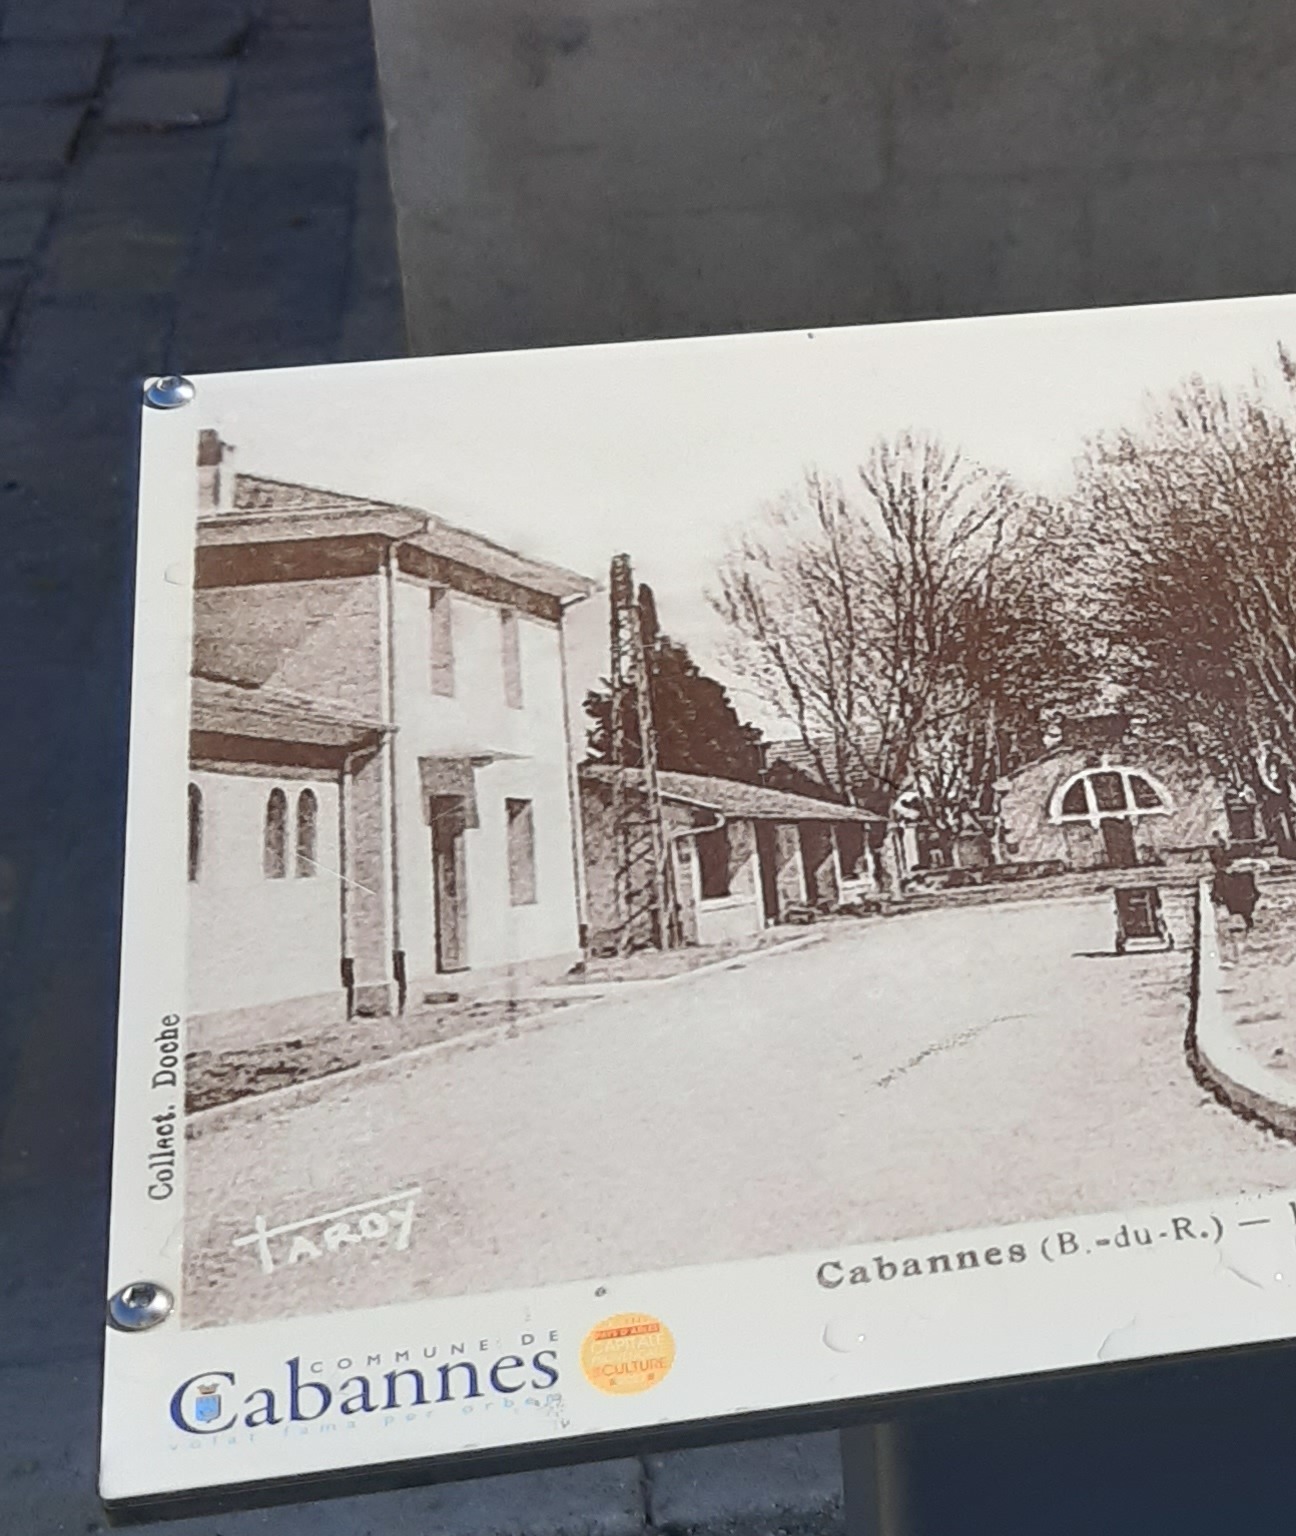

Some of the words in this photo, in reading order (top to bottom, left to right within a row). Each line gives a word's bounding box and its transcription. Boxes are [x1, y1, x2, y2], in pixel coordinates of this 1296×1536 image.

[151, 1013, 181, 1090] Doche
[815, 1240, 1029, 1289] Cabannes
[310, 1338, 489, 1374] COMMUNE
[521, 1329, 559, 1346] DE
[601, 1357, 668, 1377] CULTURE
[170, 1349, 560, 1435] Cabannes
